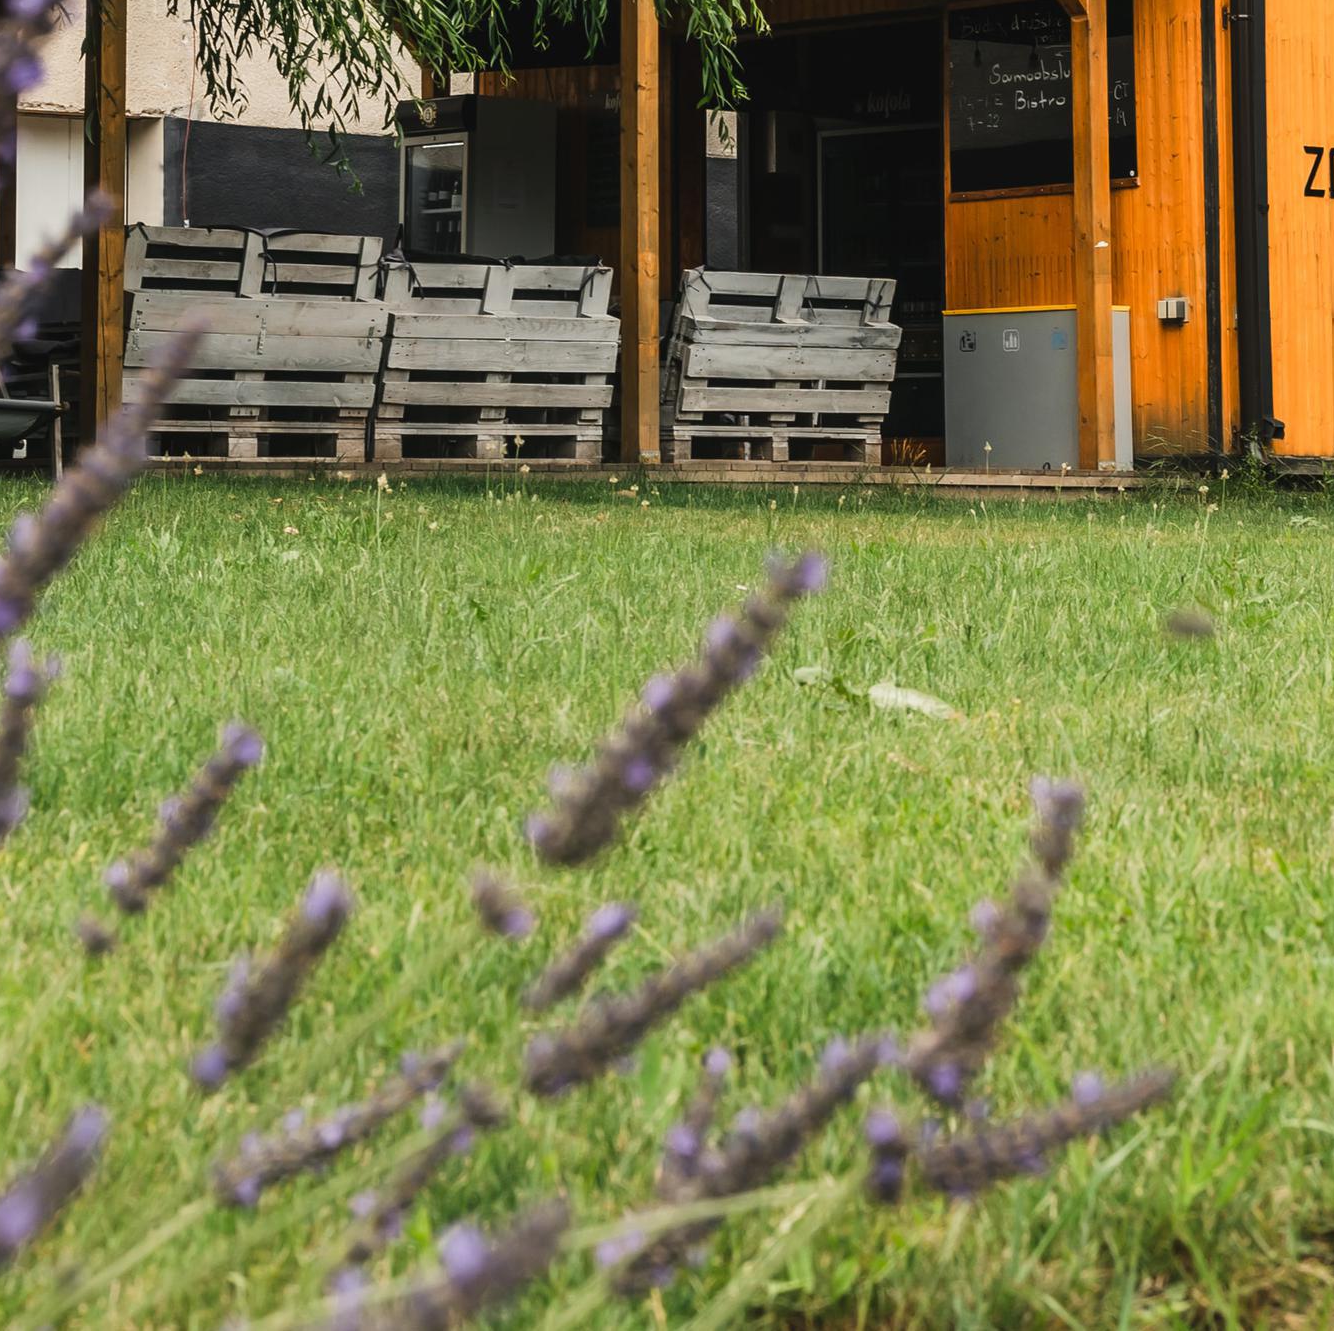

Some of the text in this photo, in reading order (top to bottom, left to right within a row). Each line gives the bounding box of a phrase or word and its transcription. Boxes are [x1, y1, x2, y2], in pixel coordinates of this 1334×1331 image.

[989, 59, 1071, 85] Samoobslu
[867, 85, 911, 119] kofola
[1015, 90, 1066, 110] Bistro
